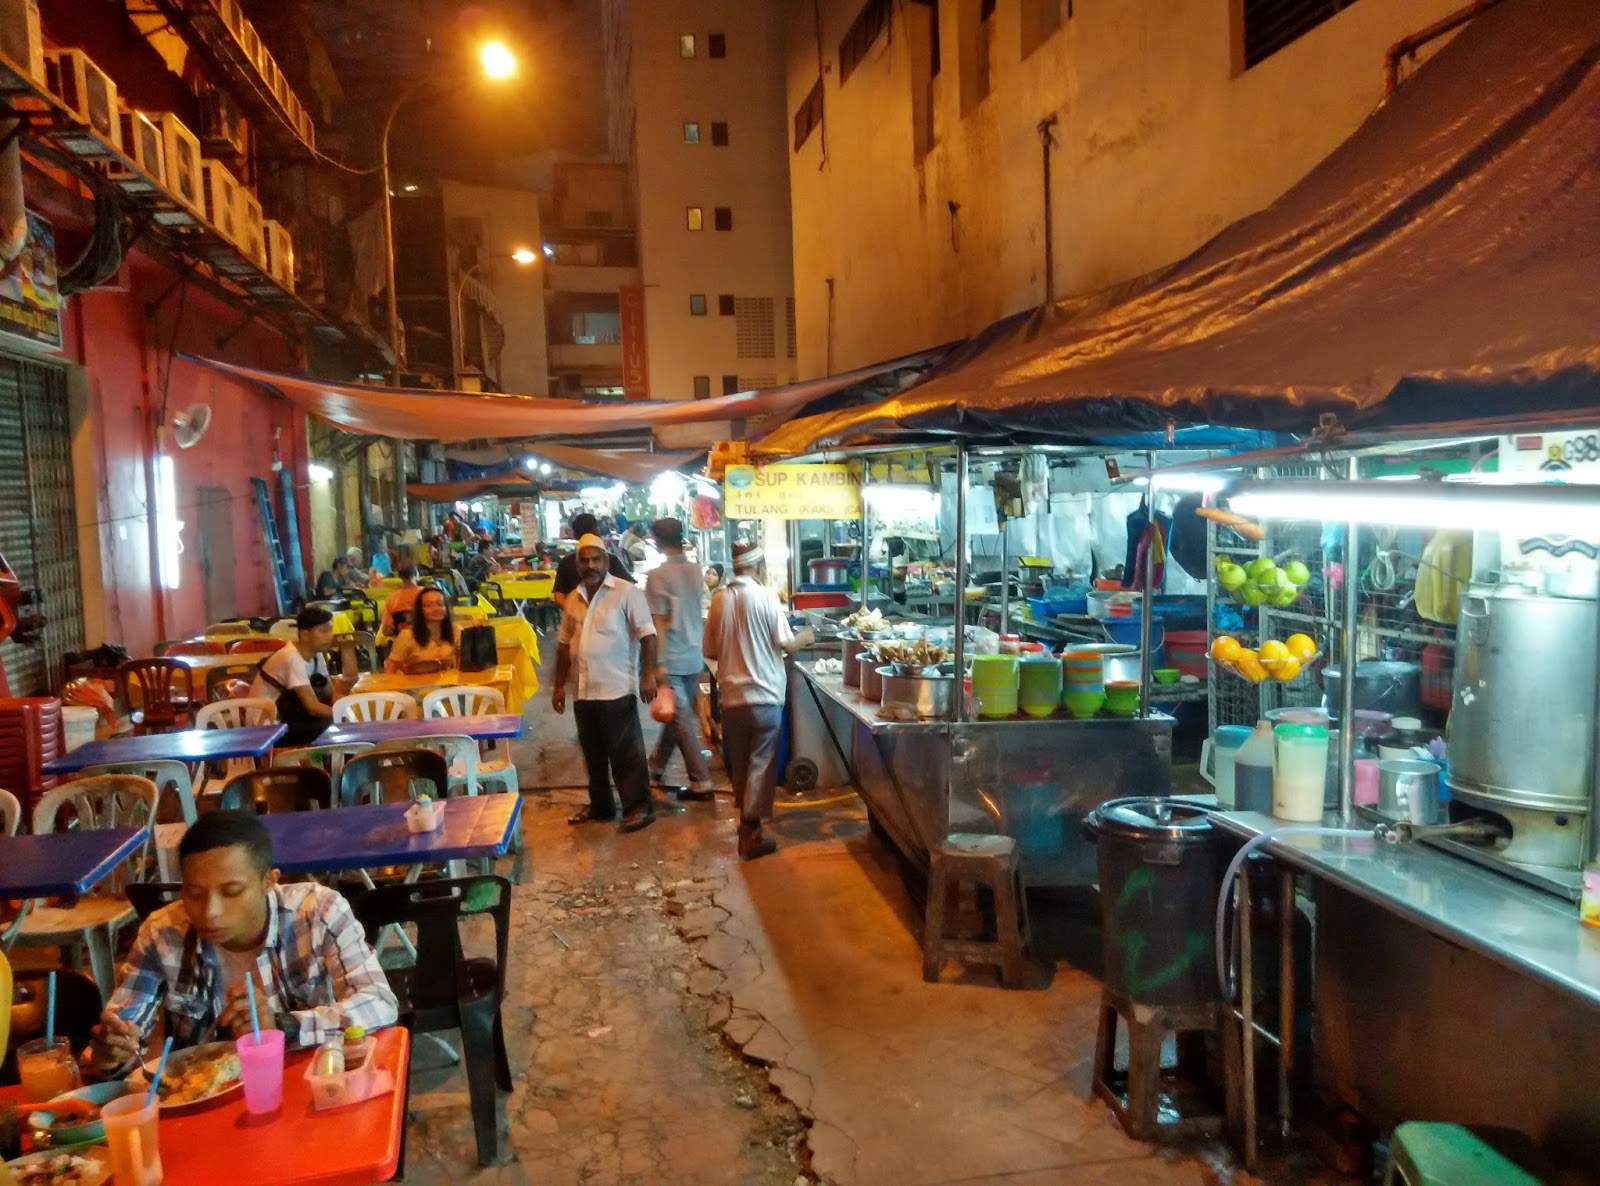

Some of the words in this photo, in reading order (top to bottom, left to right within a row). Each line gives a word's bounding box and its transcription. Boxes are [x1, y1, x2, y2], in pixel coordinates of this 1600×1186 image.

[755, 472, 788, 486] SUP
[796, 471, 862, 486] KAMBIN
[736, 504, 788, 514] TULANG
